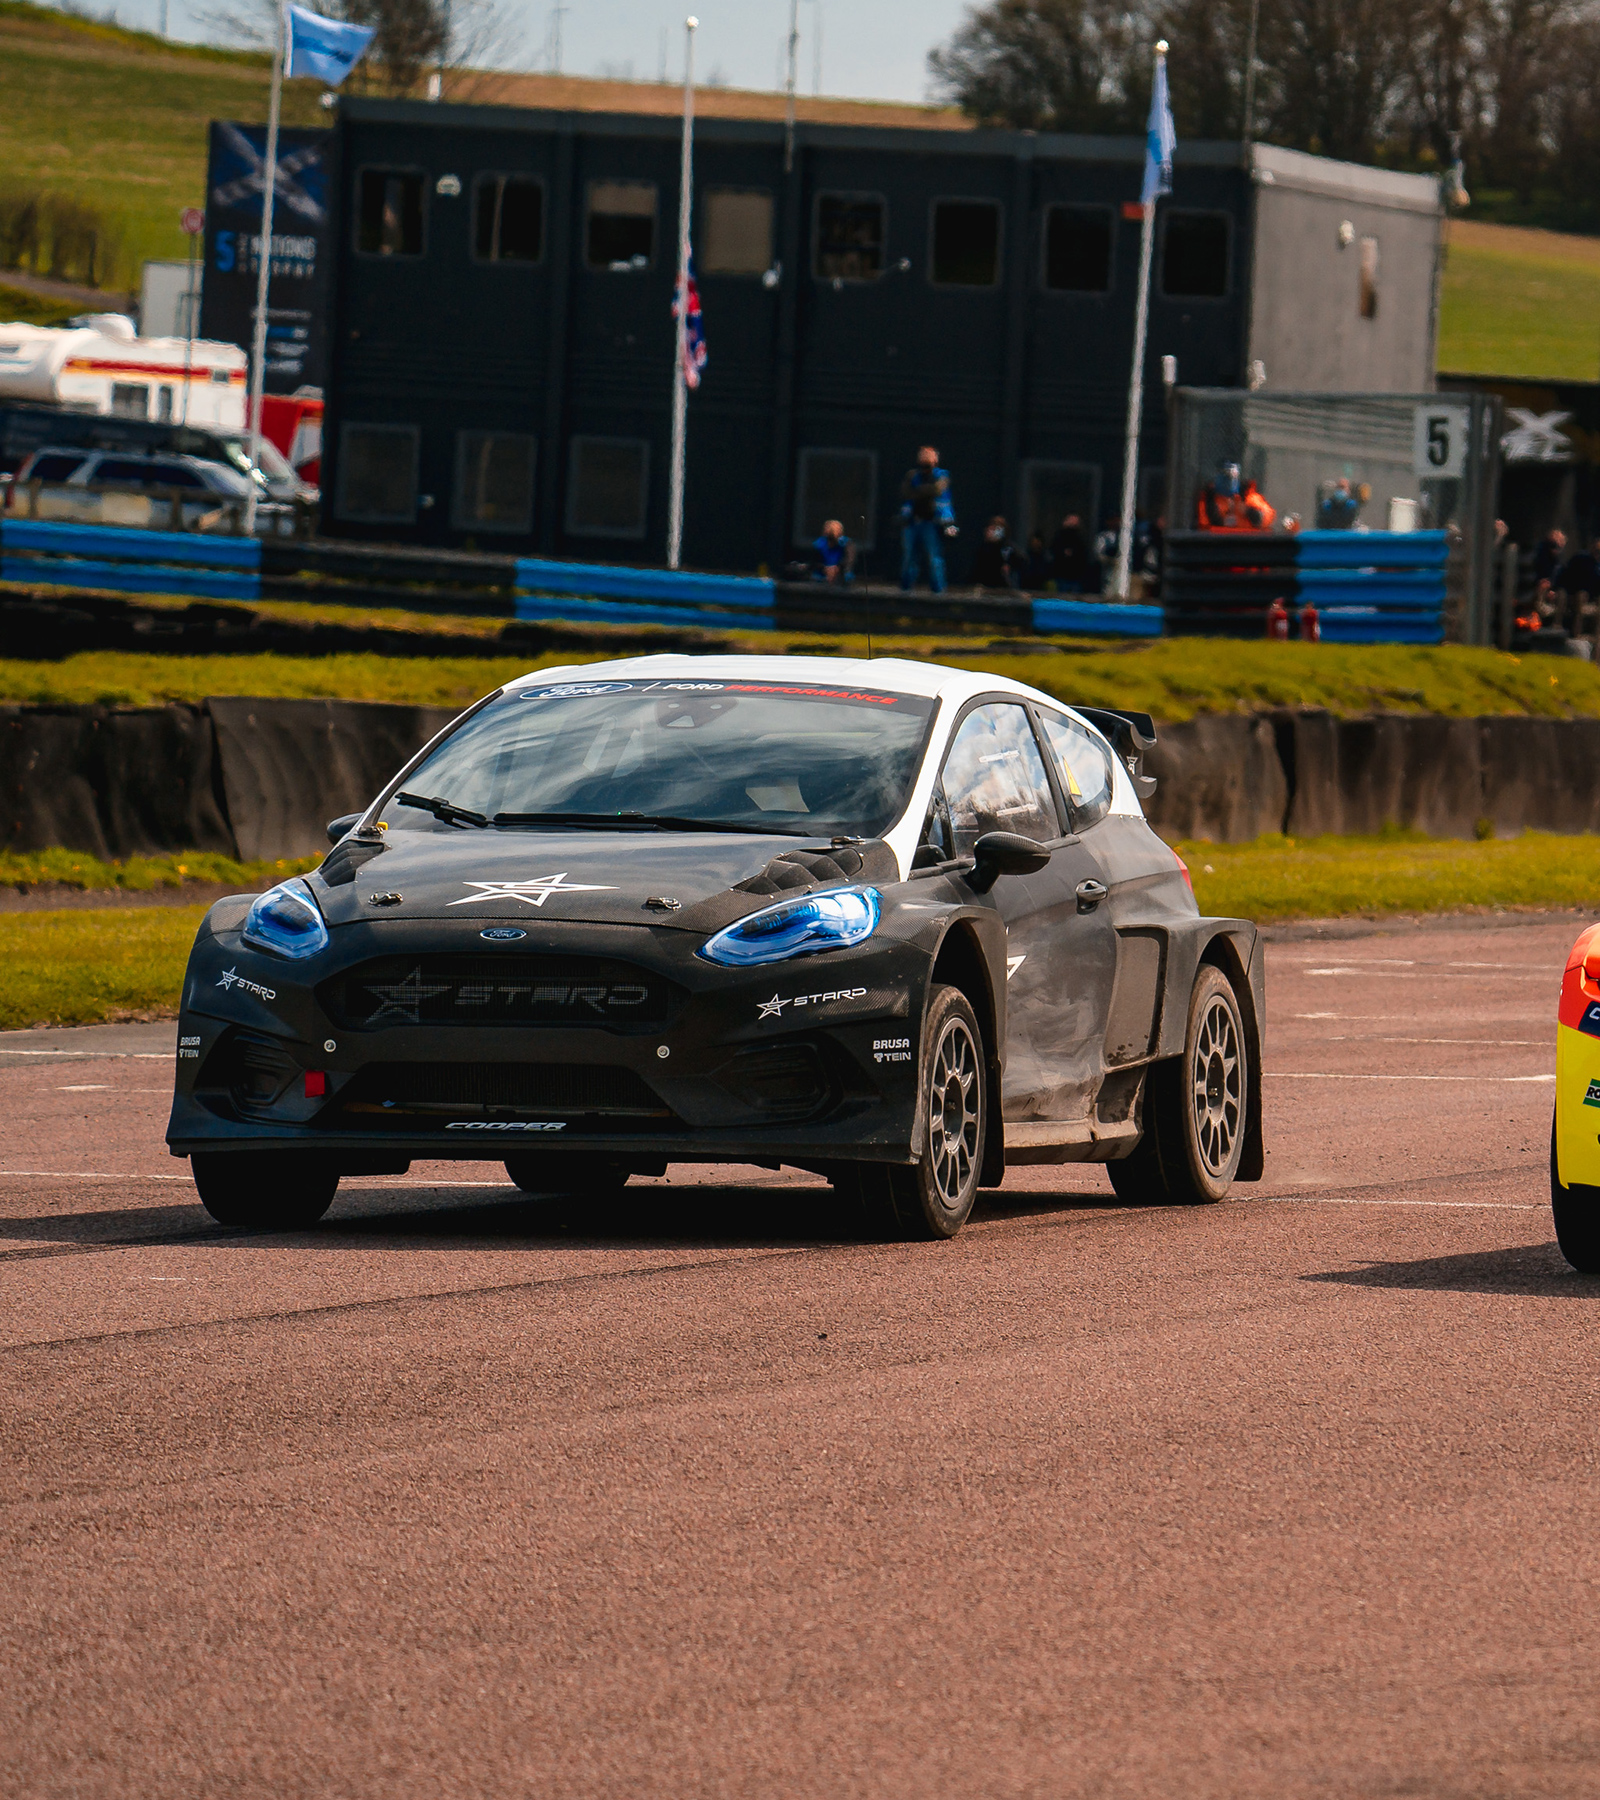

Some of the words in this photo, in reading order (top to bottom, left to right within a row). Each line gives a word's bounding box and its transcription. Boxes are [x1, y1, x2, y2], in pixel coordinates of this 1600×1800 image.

[1428, 416, 1449, 466] 5
[663, 683, 724, 691] FORD
[725, 684, 898, 705] PERFORMANCE
[237, 978, 277, 1001] STARD
[793, 987, 867, 1006] STARD
[454, 986, 648, 1013] STARD
[180, 1036, 201, 1046] BRUSA
[872, 1038, 910, 1050] BRUSA
[883, 1051, 912, 1062] TEIN
[445, 1122, 567, 1131] COOPER
